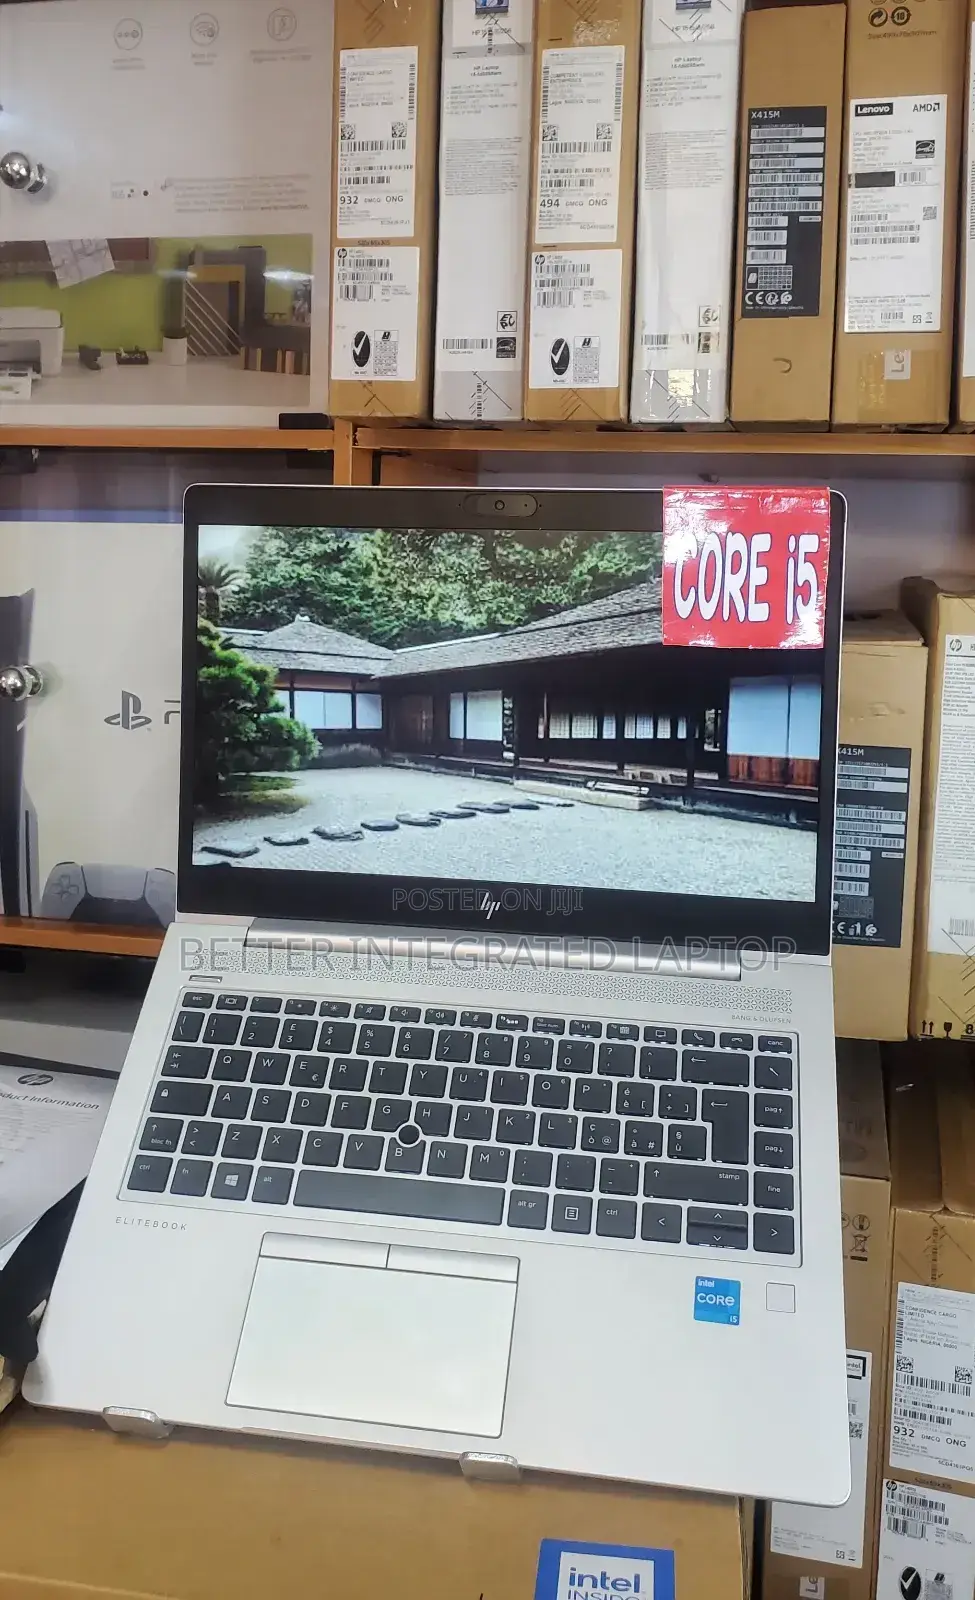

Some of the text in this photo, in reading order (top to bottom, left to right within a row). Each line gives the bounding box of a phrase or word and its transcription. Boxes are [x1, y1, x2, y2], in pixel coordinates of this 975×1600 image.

[857, 105, 891, 115] Lenovo
[913, 103, 933, 113] AMD
[751, 110, 781, 119] X415M
[339, 195, 359, 205] 932
[385, 195, 404, 203] ONG
[539, 198, 560, 208] 494
[588, 198, 608, 207] ONG
[673, 531, 820, 625] CORE i5
[731, 1014, 750, 1022] BANG
[759, 1016, 792, 1024] OLUFSEN
[767, 1039, 784, 1047] canc
[29, 1096, 100, 1110] Information
[151, 1137, 164, 1145] bloc
[601, 1135, 612, 1145] @
[764, 1145, 778, 1153] pag
[718, 1172, 740, 1181] stamp
[767, 1185, 781, 1193] fine
[605, 1208, 618, 1216] ctrl
[115, 1216, 188, 1231] ELITEBOOK
[698, 1278, 715, 1288] intel
[904, 1311, 925, 1319] LIMITED
[905, 1305, 957, 1319] CONFIDENCE CARGO
[893, 1425, 967, 1448] 932 DMCQ ONG
[569, 1567, 641, 1594] intel
